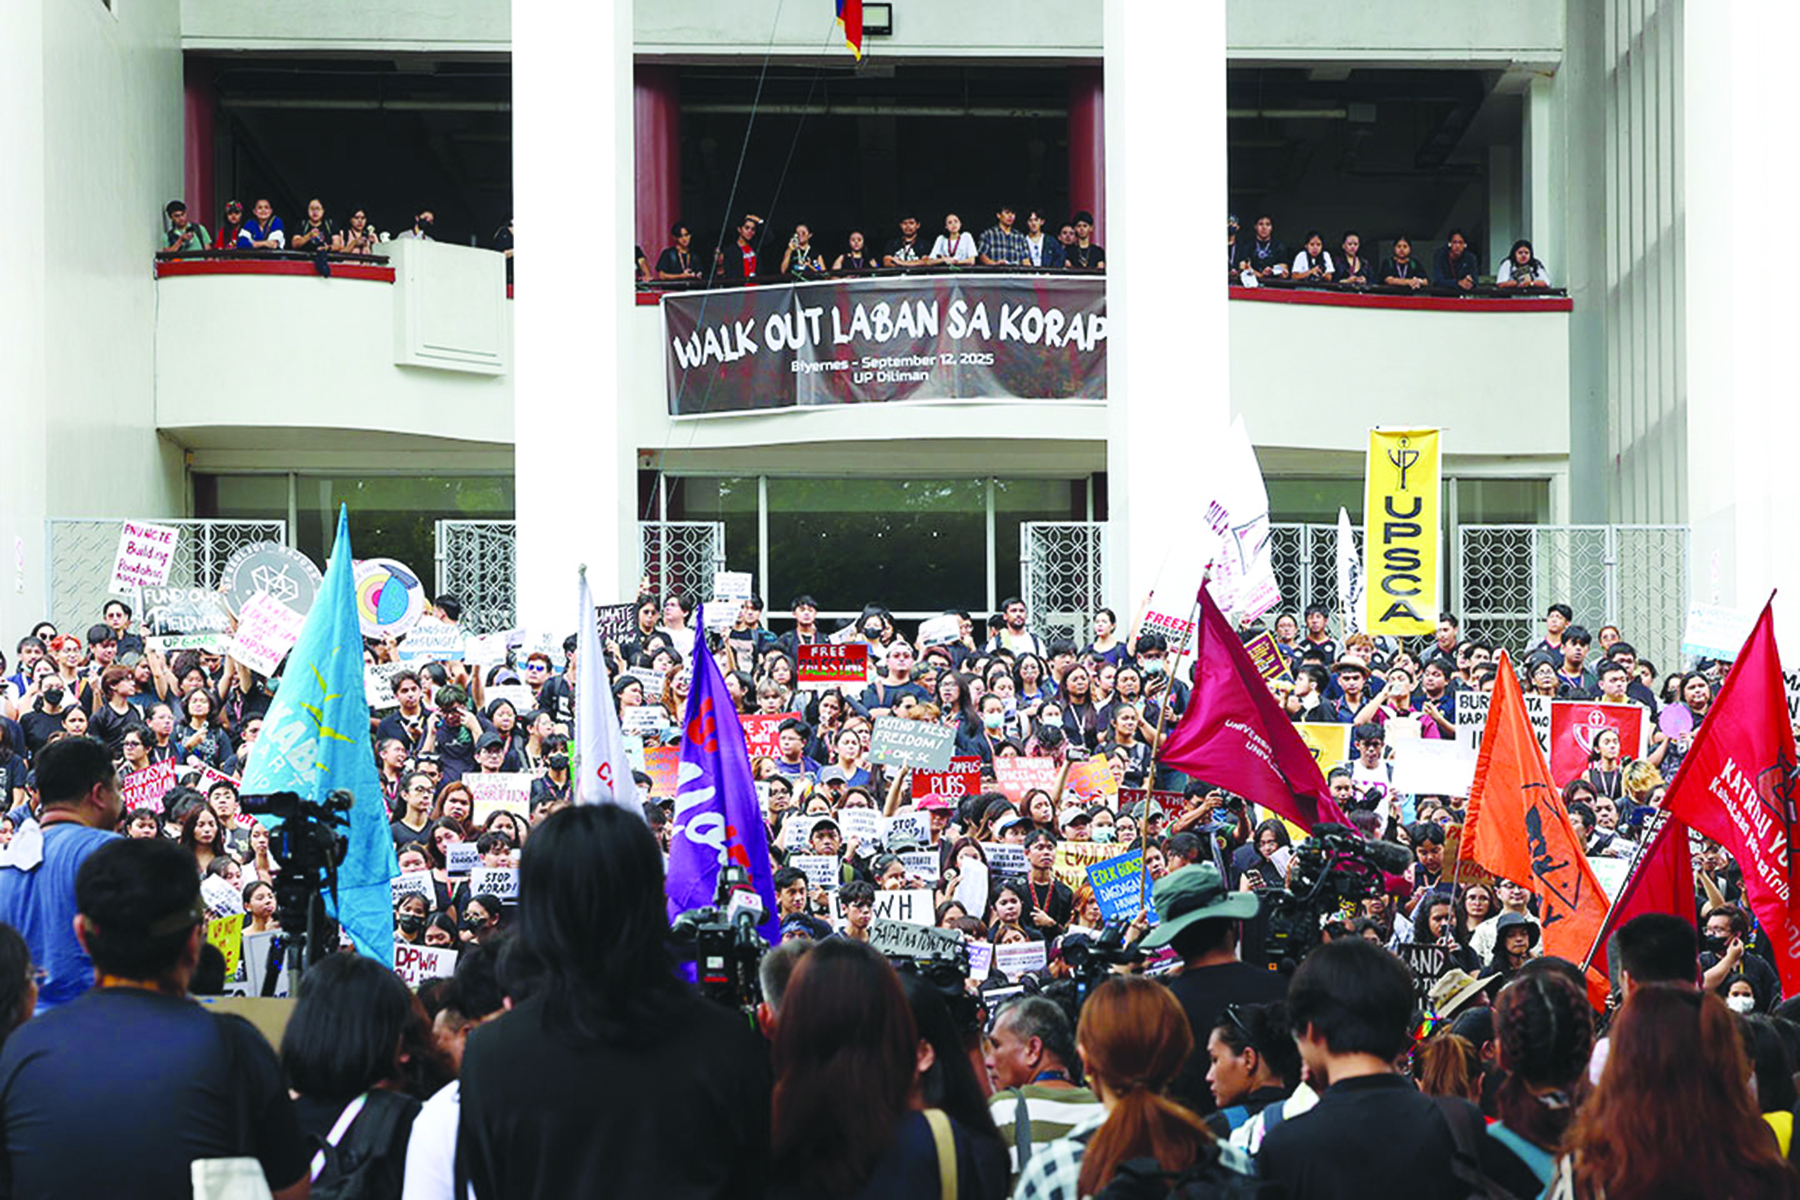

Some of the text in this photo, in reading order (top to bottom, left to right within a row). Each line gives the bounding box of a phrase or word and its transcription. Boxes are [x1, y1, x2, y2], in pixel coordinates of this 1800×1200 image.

[673, 318, 758, 369] WALK
[764, 309, 824, 350] OUT
[831, 300, 940, 344] LABAN
[946, 300, 991, 342] SA
[791, 358, 849, 373] Biyernes
[861, 356, 937, 370] September
[940, 354, 958, 368] 12,
[960, 353, 995, 366] 2025
[854, 370, 929, 384] UP Diliman
[126, 540, 169, 567] Building
[1378, 496, 1424, 622] UPSCA
[144, 588, 184, 604] FUND
[596, 606, 635, 622] LIMATE
[1144, 610, 1196, 634] FREEZE
[810, 646, 847, 657] FREE
[798, 658, 866, 677] PALESTINE
[878, 718, 916, 733] DEFEND
[874, 730, 944, 750] FREEDOM!
[747, 744, 782, 760] AZA
[930, 774, 966, 798] PUBS
[892, 818, 918, 831] STOP
[1116, 857, 1143, 878] BUDGE
[484, 872, 511, 884] STOP
[477, 882, 518, 894] KORAP!
[394, 946, 439, 973] DPWH
